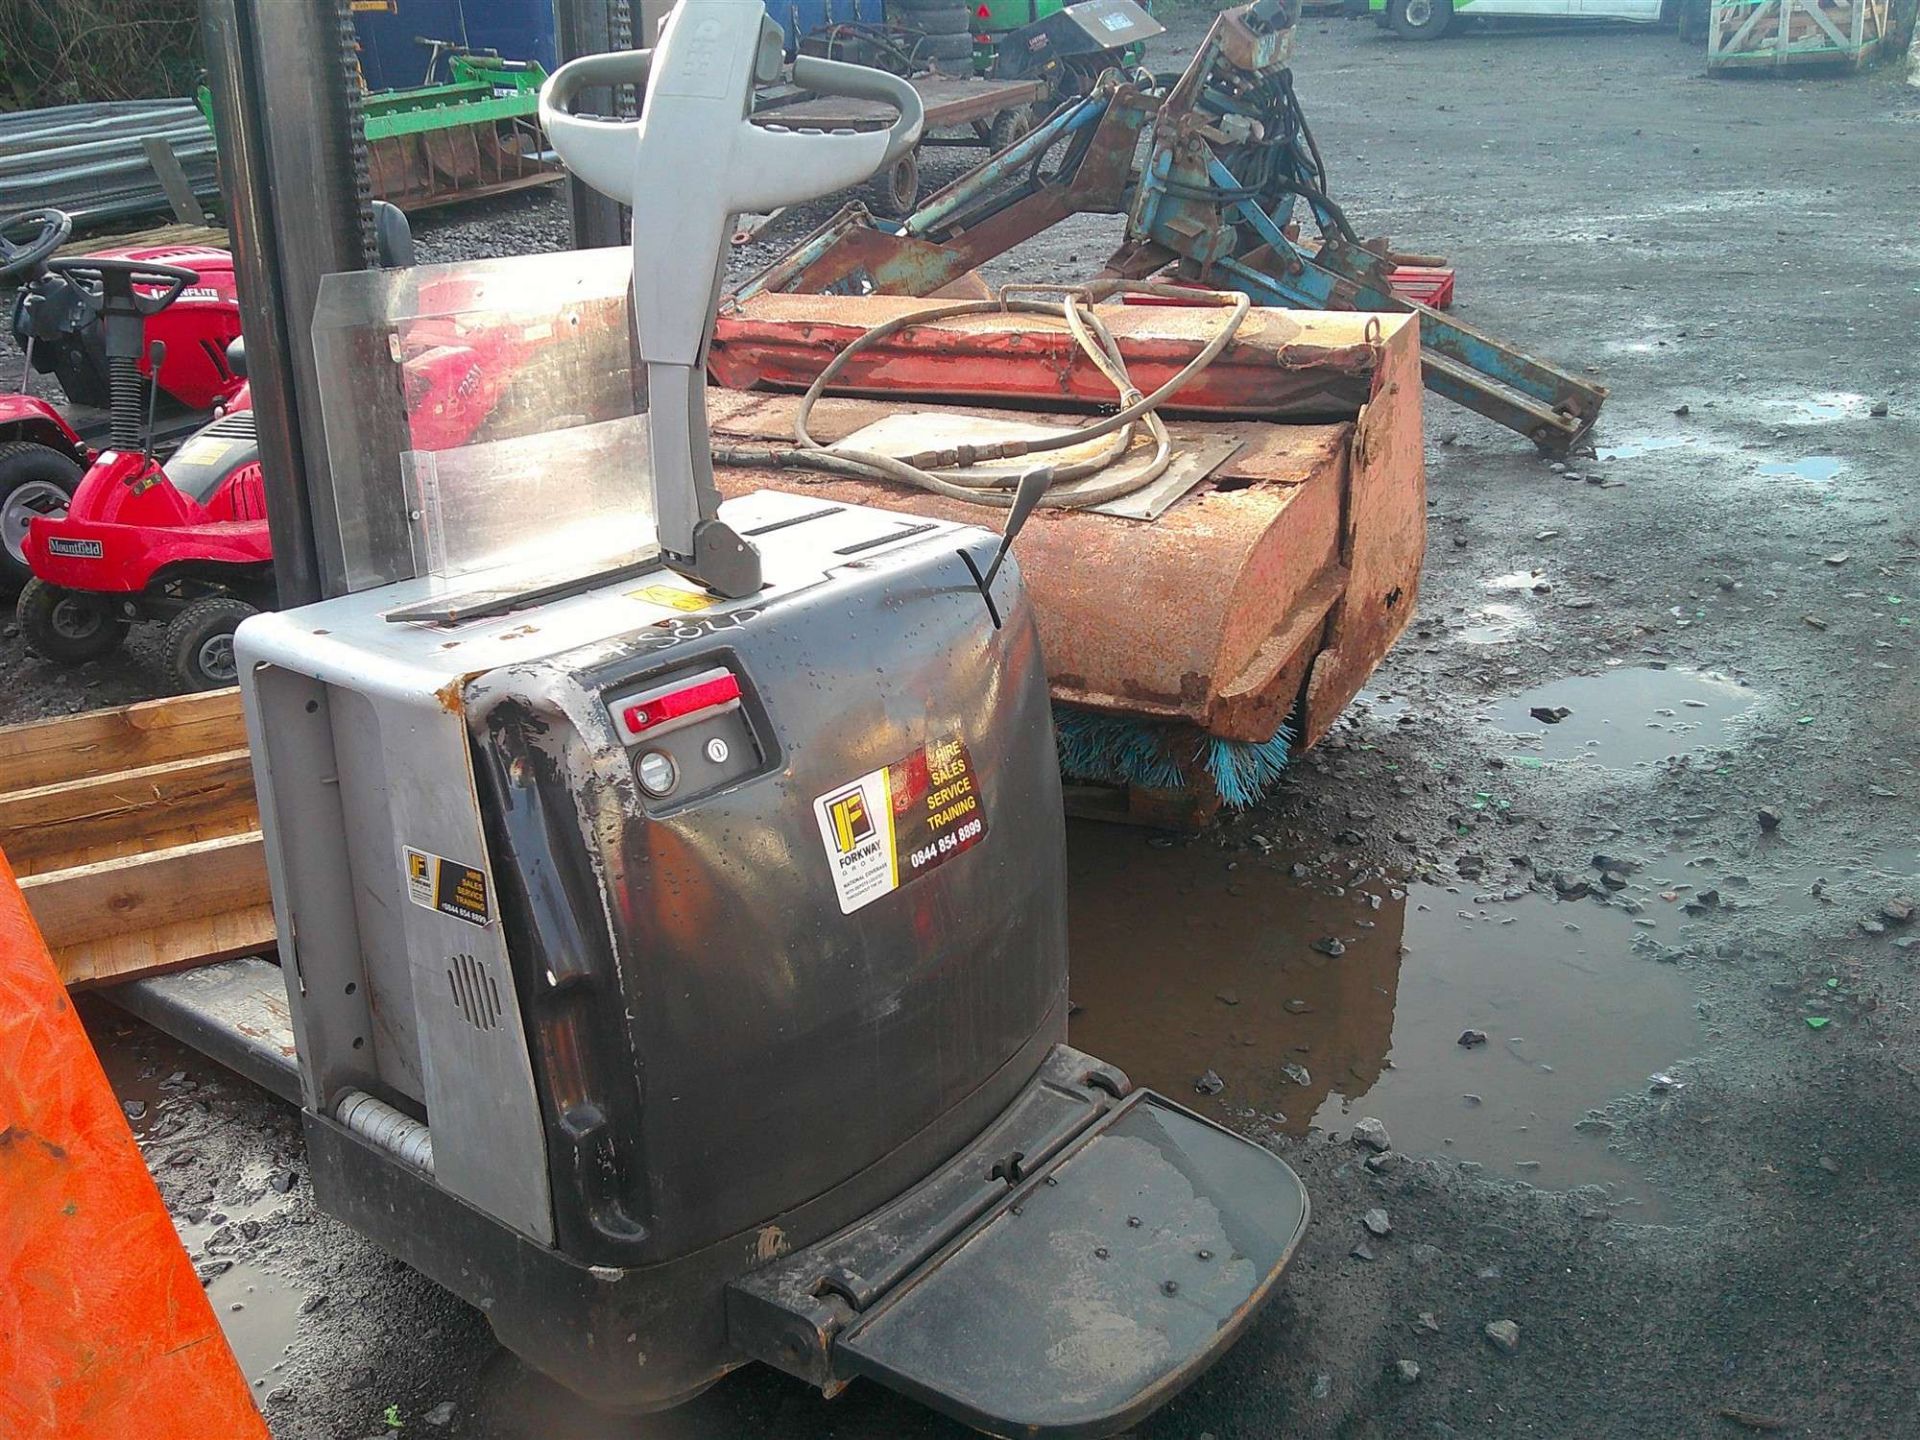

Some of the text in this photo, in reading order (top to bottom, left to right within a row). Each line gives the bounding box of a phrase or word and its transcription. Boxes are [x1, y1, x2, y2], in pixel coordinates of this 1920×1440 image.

[50, 540, 100, 555] Mountfield
[638, 609, 761, 648] SOLD
[931, 758, 966, 786] SALES
[926, 777, 972, 810] SERVICE
[926, 795, 976, 831] TRAINING
[839, 839, 881, 869] FORKWAY
[911, 818, 981, 868] 0844 854 8899
[842, 852, 883, 876] GROUP
